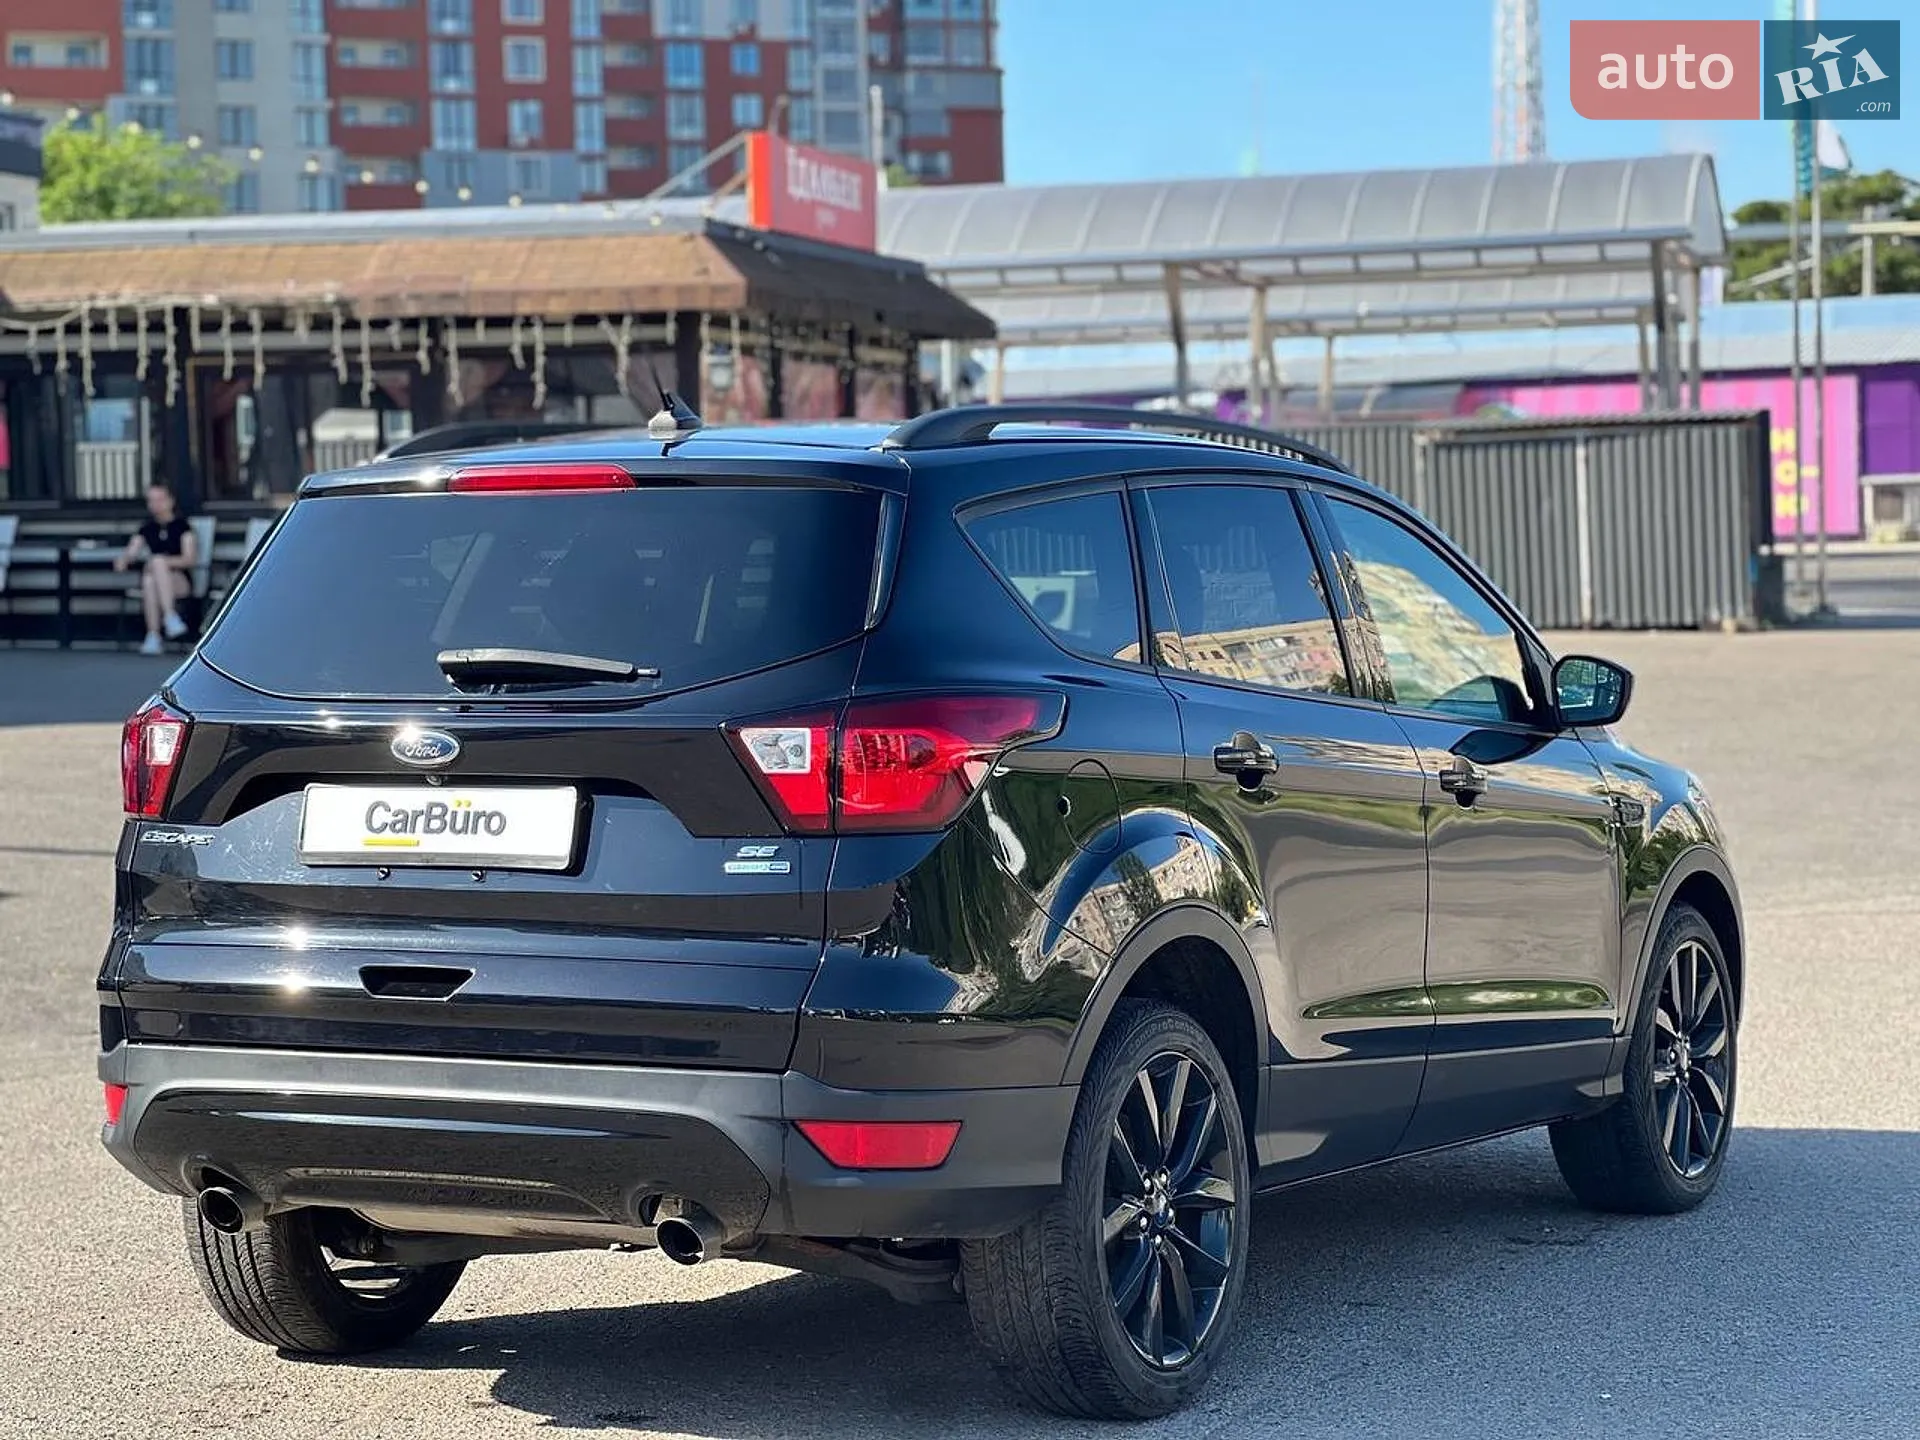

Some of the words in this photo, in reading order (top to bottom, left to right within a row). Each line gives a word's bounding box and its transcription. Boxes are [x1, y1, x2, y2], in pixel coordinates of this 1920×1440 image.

[402, 738, 442, 758] Ford
[365, 800, 507, 837] CarBüro
[736, 845, 780, 858] SE
